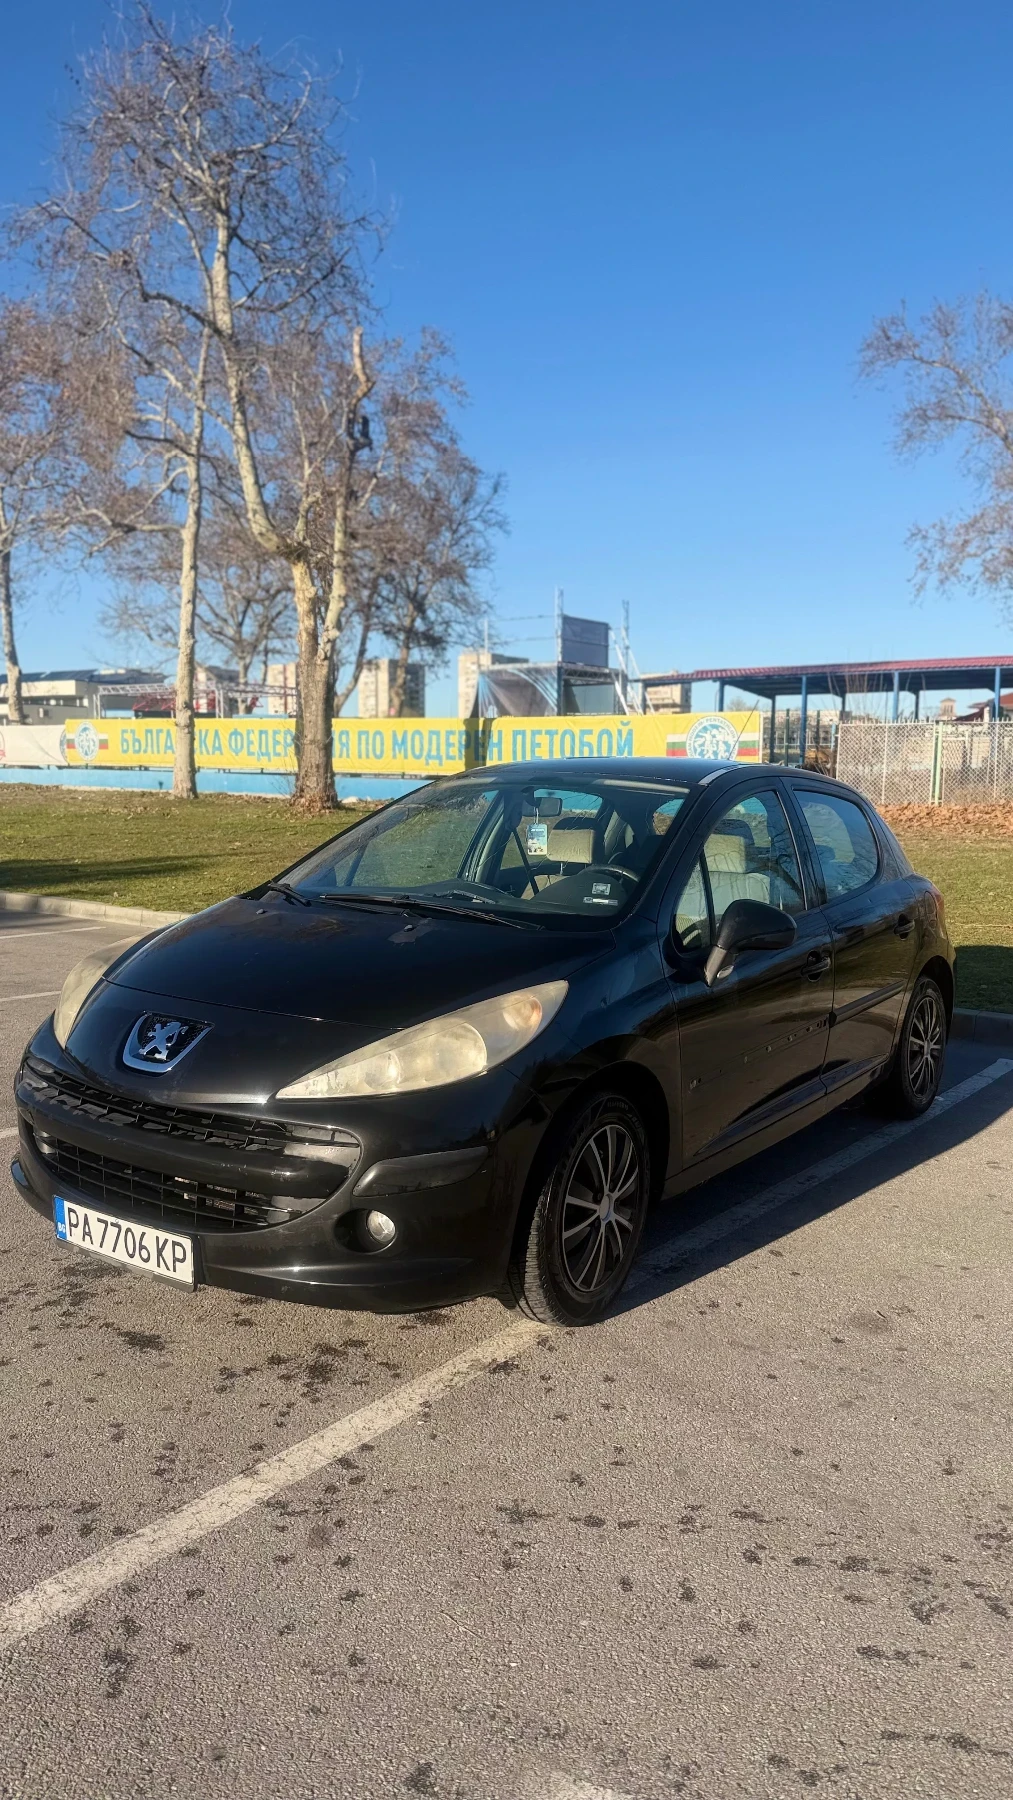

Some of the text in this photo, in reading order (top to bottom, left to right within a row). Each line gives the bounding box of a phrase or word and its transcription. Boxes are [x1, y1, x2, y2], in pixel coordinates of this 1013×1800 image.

[120, 728, 223, 756] БЪЛГАКА
[228, 728, 351, 763] ФЕДЕРЯ
[357, 729, 385, 760] ПО
[391, 728, 503, 766] МОДЕРЕН
[512, 720, 634, 762] ПЕТОБОЙ
[57, 1221, 66, 1234] BG
